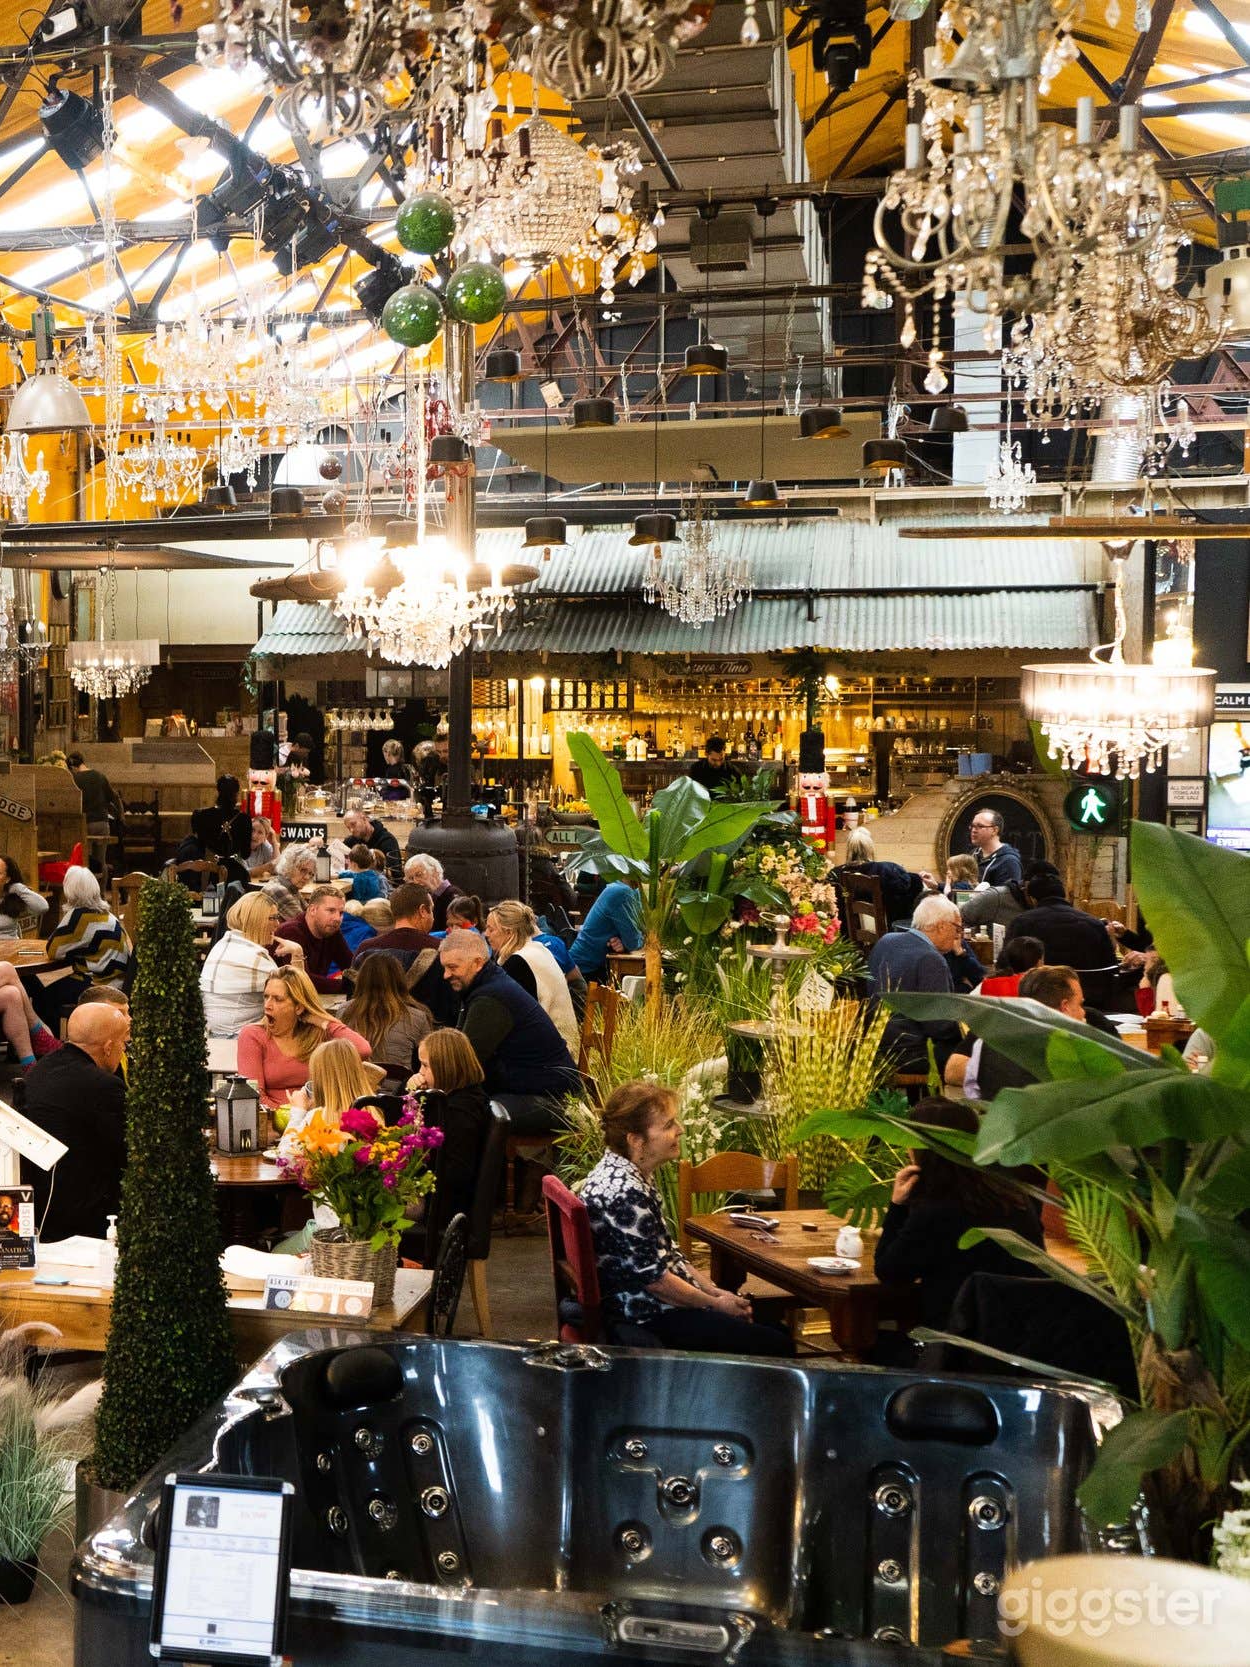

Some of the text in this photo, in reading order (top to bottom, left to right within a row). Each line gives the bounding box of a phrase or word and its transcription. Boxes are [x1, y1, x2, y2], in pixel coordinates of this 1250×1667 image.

[1215, 696, 1245, 704] CALM
[280, 827, 325, 839] GWARTS
[553, 831, 570, 842] ALL
